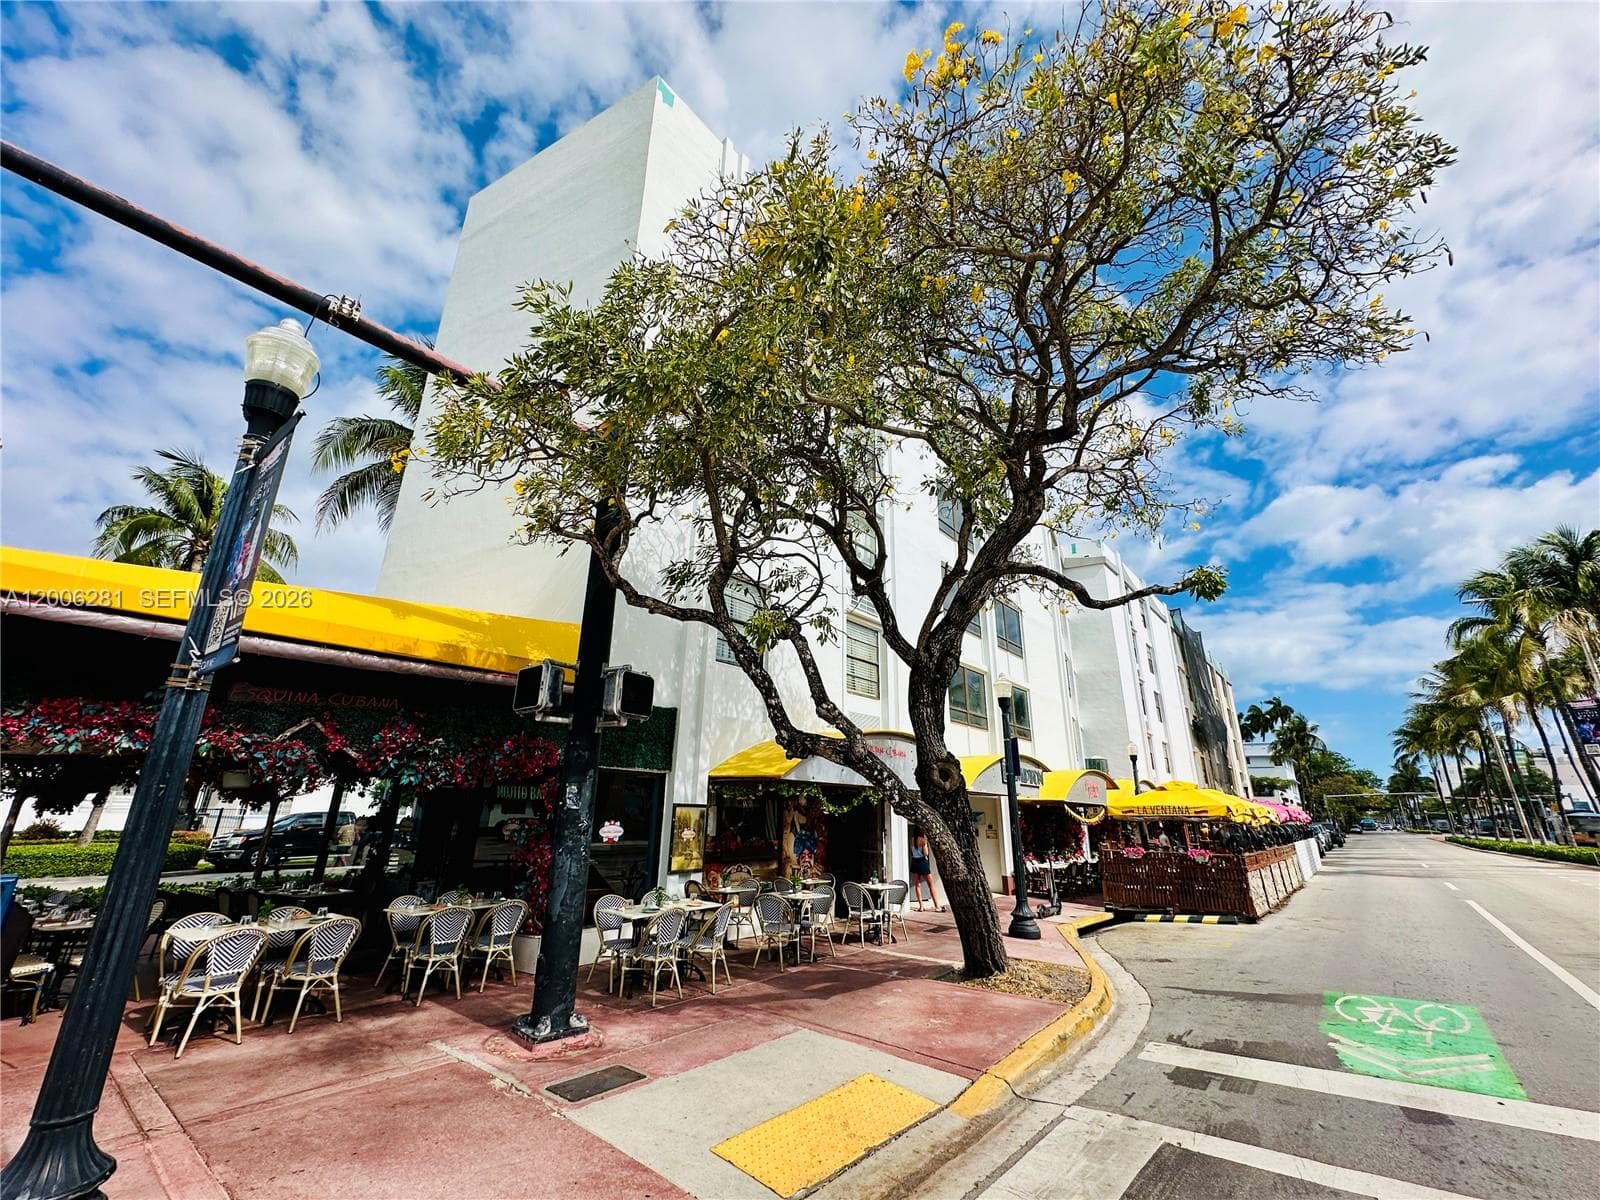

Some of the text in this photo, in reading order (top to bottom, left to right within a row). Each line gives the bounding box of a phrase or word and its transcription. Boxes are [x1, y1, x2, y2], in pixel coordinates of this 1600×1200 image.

[228, 682, 400, 709] ESQUINA CUBANA
[530, 786, 545, 800] BA
[1136, 805, 1191, 815] LA VENTANA
